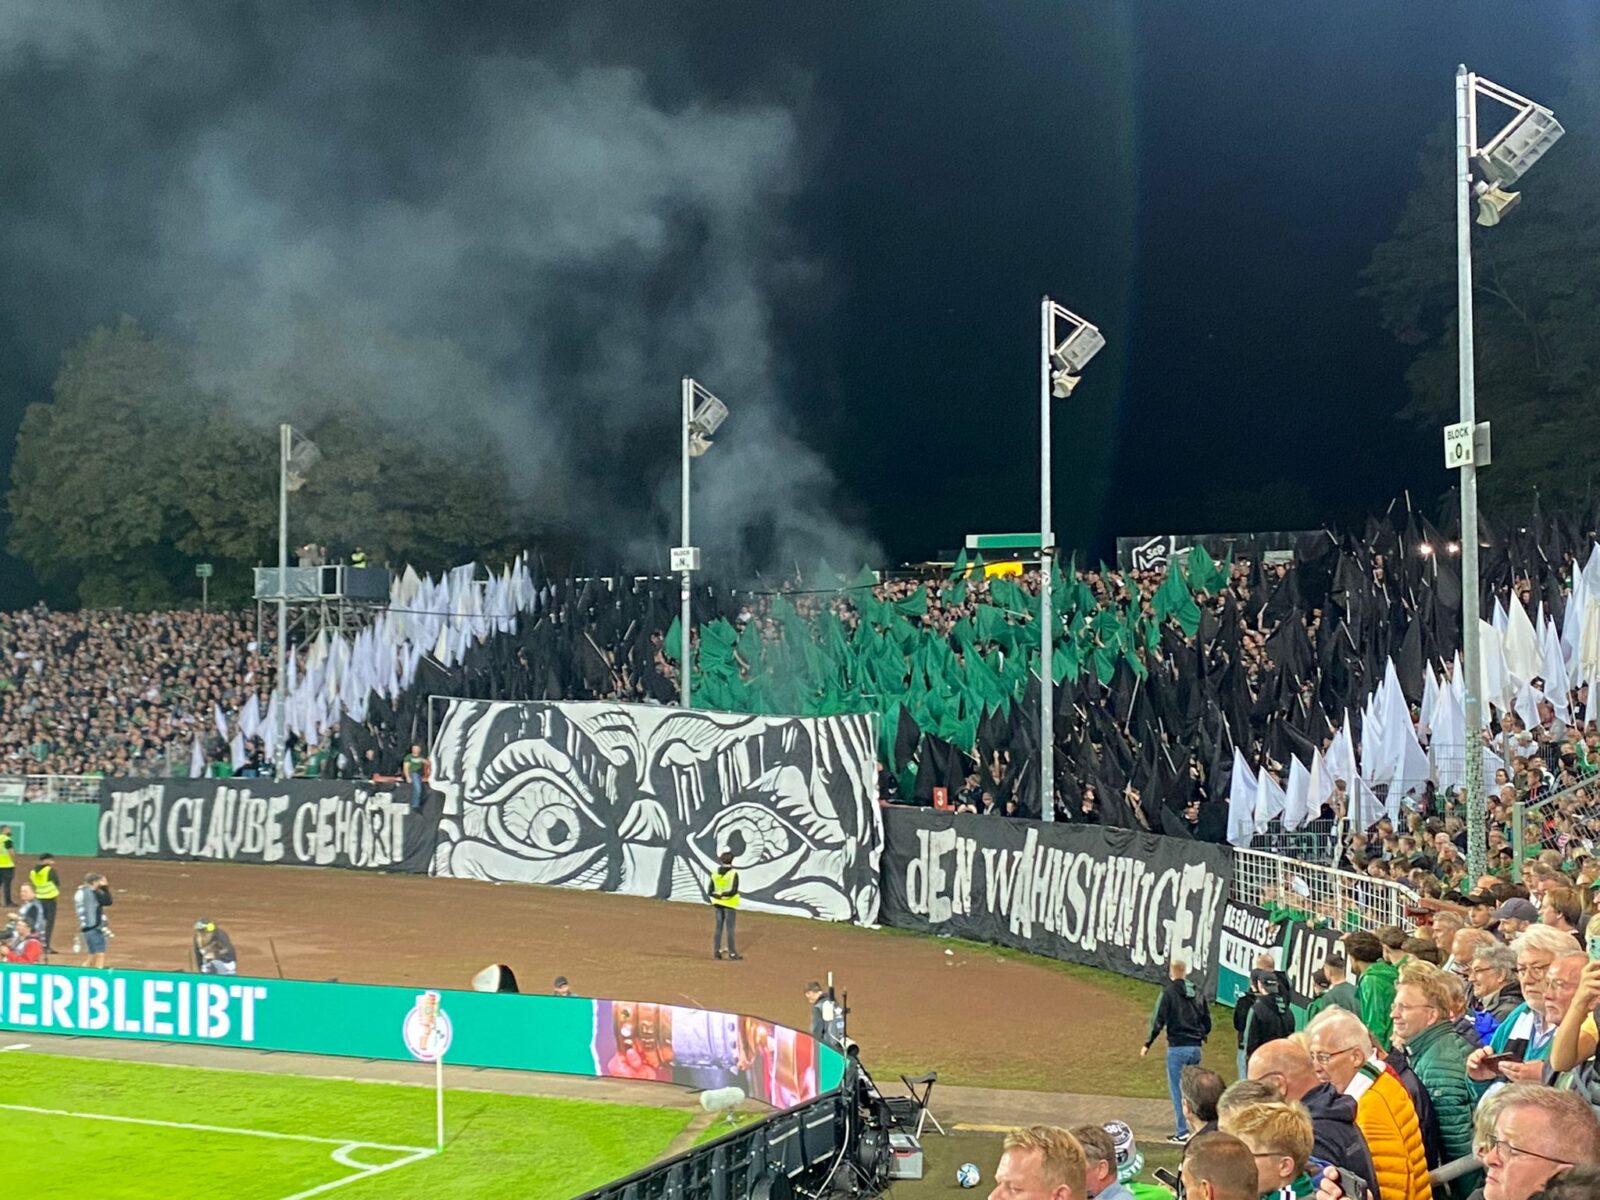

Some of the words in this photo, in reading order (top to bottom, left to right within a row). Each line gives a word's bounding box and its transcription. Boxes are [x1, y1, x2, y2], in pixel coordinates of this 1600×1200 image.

[1448, 427, 1469, 440] BLOCK
[167, 786, 289, 862] GLAUBE
[293, 788, 410, 868] GEHÖRT
[981, 827, 1224, 976] WAHNSINNIGEN
[0, 970, 268, 1042] ERBLEIBT
